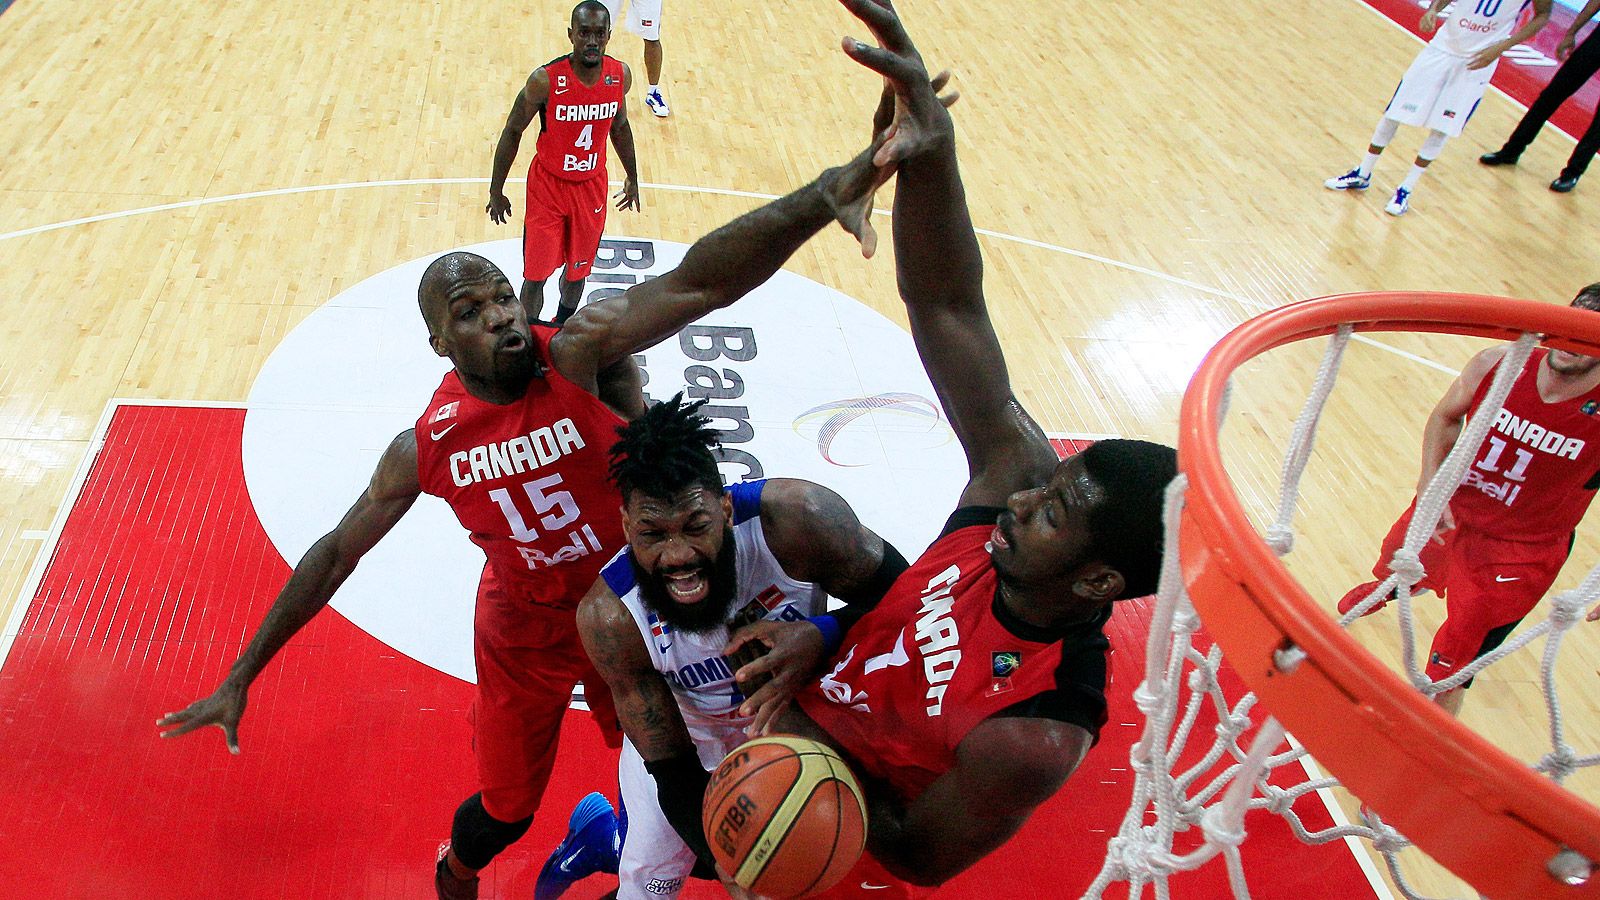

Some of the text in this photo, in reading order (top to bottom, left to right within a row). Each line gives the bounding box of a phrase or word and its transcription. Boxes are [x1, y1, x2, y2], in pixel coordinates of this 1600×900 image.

[1459, 18, 1490, 33] Claro
[555, 101, 619, 121] CANADA
[563, 152, 598, 172] Bell
[574, 124, 593, 151] 4
[678, 325, 764, 487] Banc
[449, 417, 586, 488] CANADA
[1475, 435, 1534, 482] 11
[1491, 407, 1586, 461] ANADA
[488, 472, 581, 543] 15
[717, 793, 757, 844] FIBA
